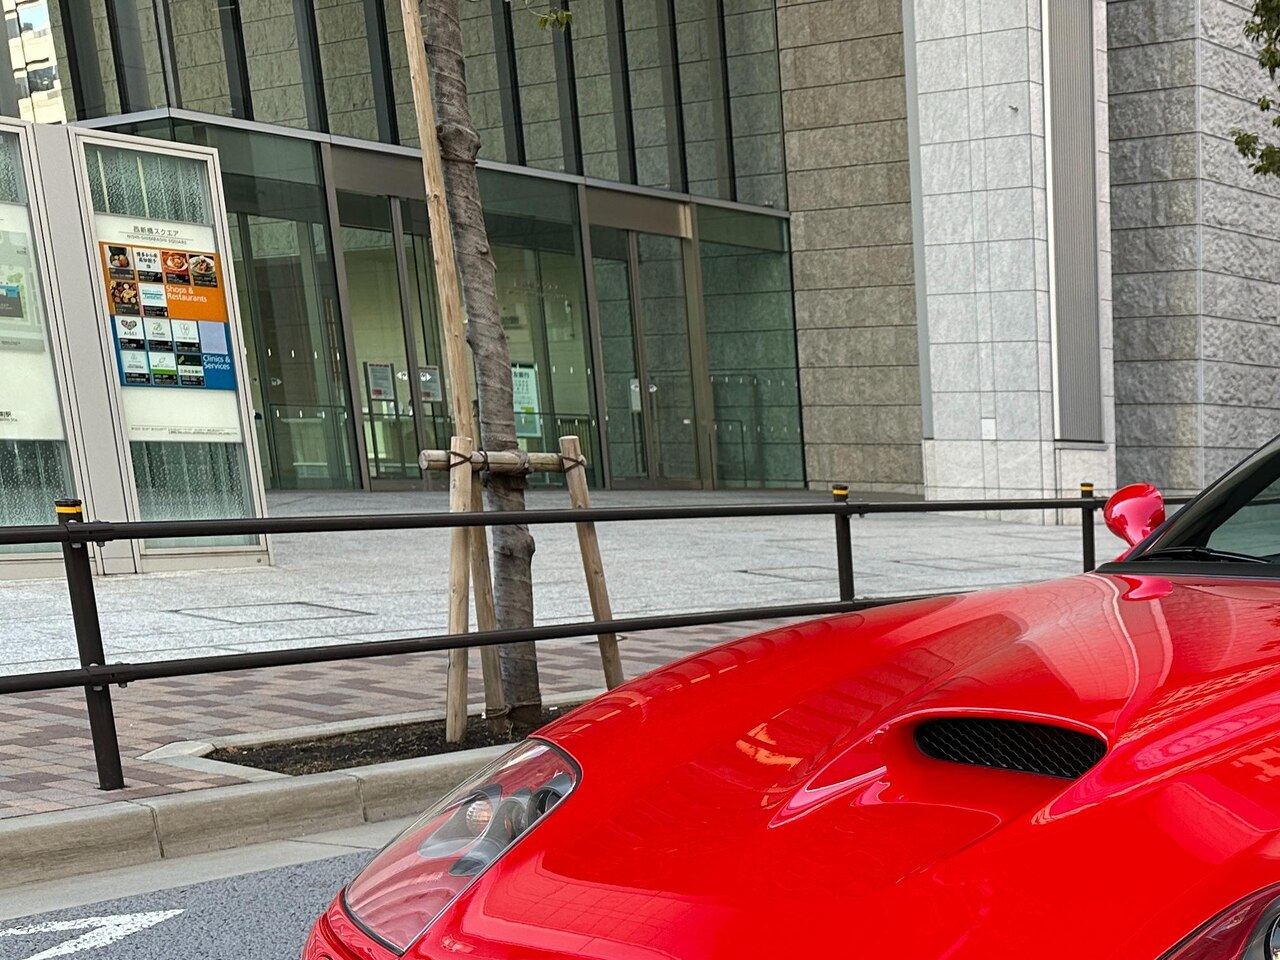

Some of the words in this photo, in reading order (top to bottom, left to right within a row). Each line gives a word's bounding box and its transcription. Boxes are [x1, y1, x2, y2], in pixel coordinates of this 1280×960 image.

[165, 285, 188, 295] Shops
[167, 291, 208, 303] Restaurants
[202, 354, 223, 364] Clinics
[203, 361, 231, 370] Services
